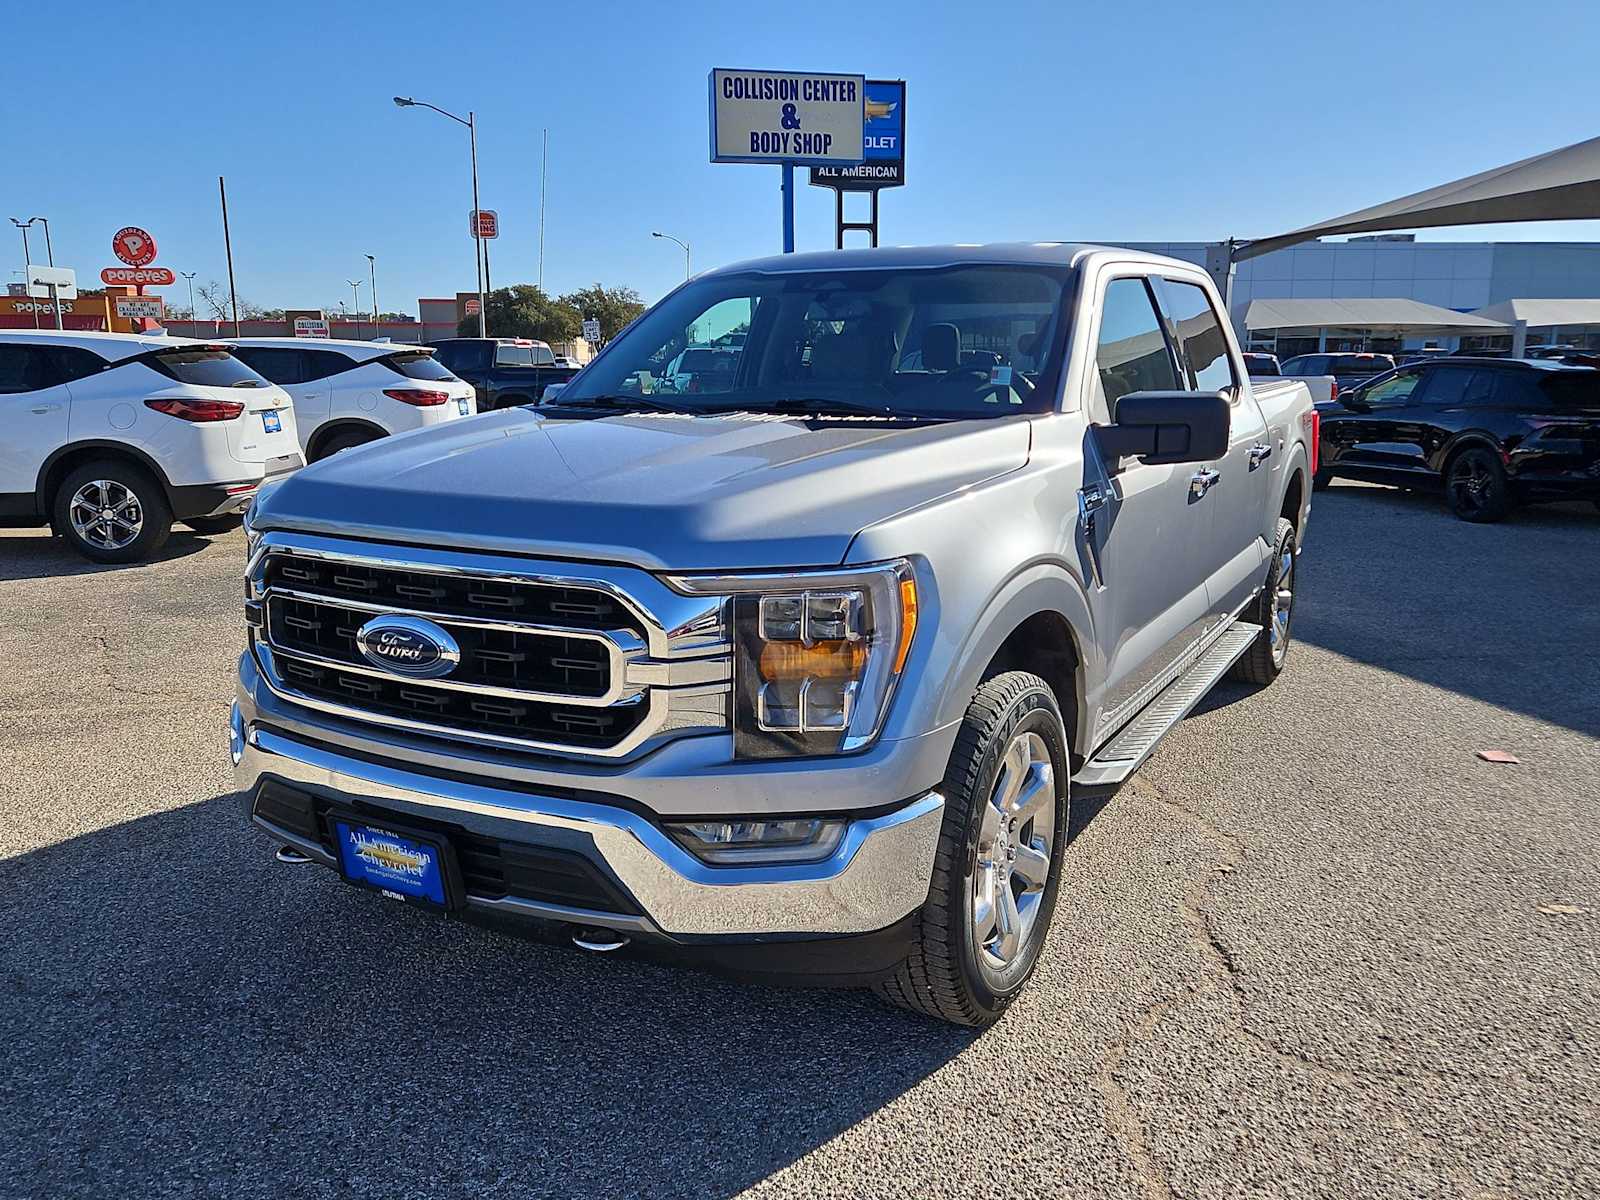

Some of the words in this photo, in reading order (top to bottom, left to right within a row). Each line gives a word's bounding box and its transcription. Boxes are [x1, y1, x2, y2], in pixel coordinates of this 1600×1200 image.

[723, 77, 799, 101] COLLISION
[803, 79, 857, 102] CENTER
[781, 103, 800, 130] &
[750, 131, 790, 154] BODY
[793, 133, 832, 155] SHOP
[818, 167, 838, 177] ALL
[841, 166, 898, 178] AMERICAN
[114, 228, 151, 244] LOUISIANA
[116, 252, 151, 265] KITCHEN
[585, 332, 599, 340] 35
[377, 632, 423, 660] Ford
[366, 826, 385, 836] SINCE
[349, 831, 366, 845] All
[369, 838, 431, 864] American
[361, 850, 424, 877] Chevrolet
